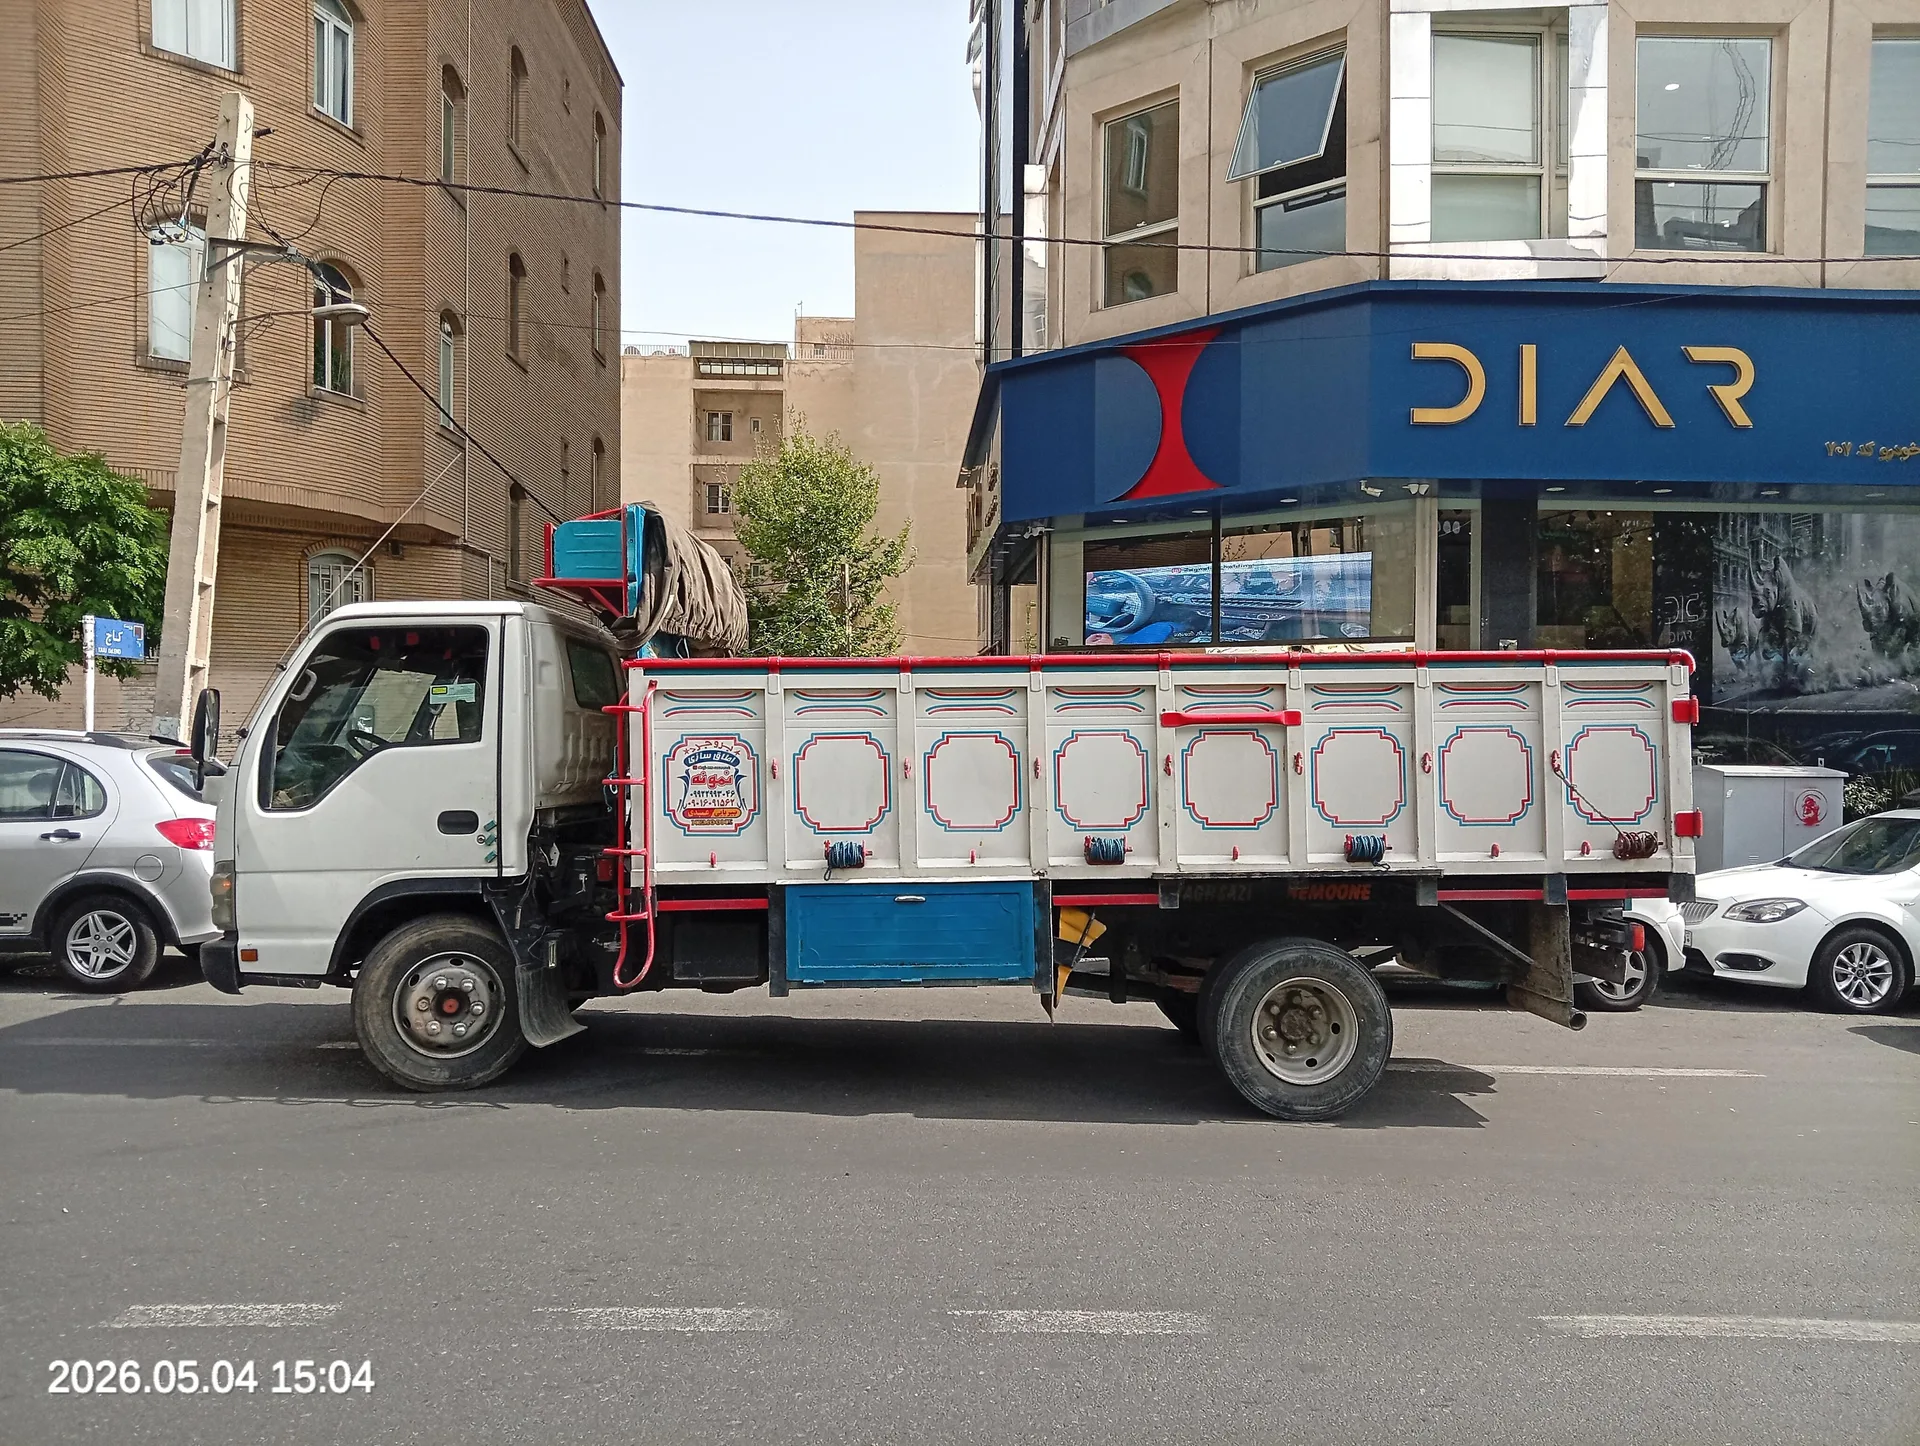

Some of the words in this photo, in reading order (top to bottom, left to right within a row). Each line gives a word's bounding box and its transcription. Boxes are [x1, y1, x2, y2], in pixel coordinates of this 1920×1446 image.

[1411, 343, 1756, 428] DIAR
[1856, 440, 1876, 457] کد
[105, 629, 124, 646] کاج
[690, 741, 734, 752] بروجرد
[688, 753, 712, 764] سازی
[690, 770, 734, 789] نمونه
